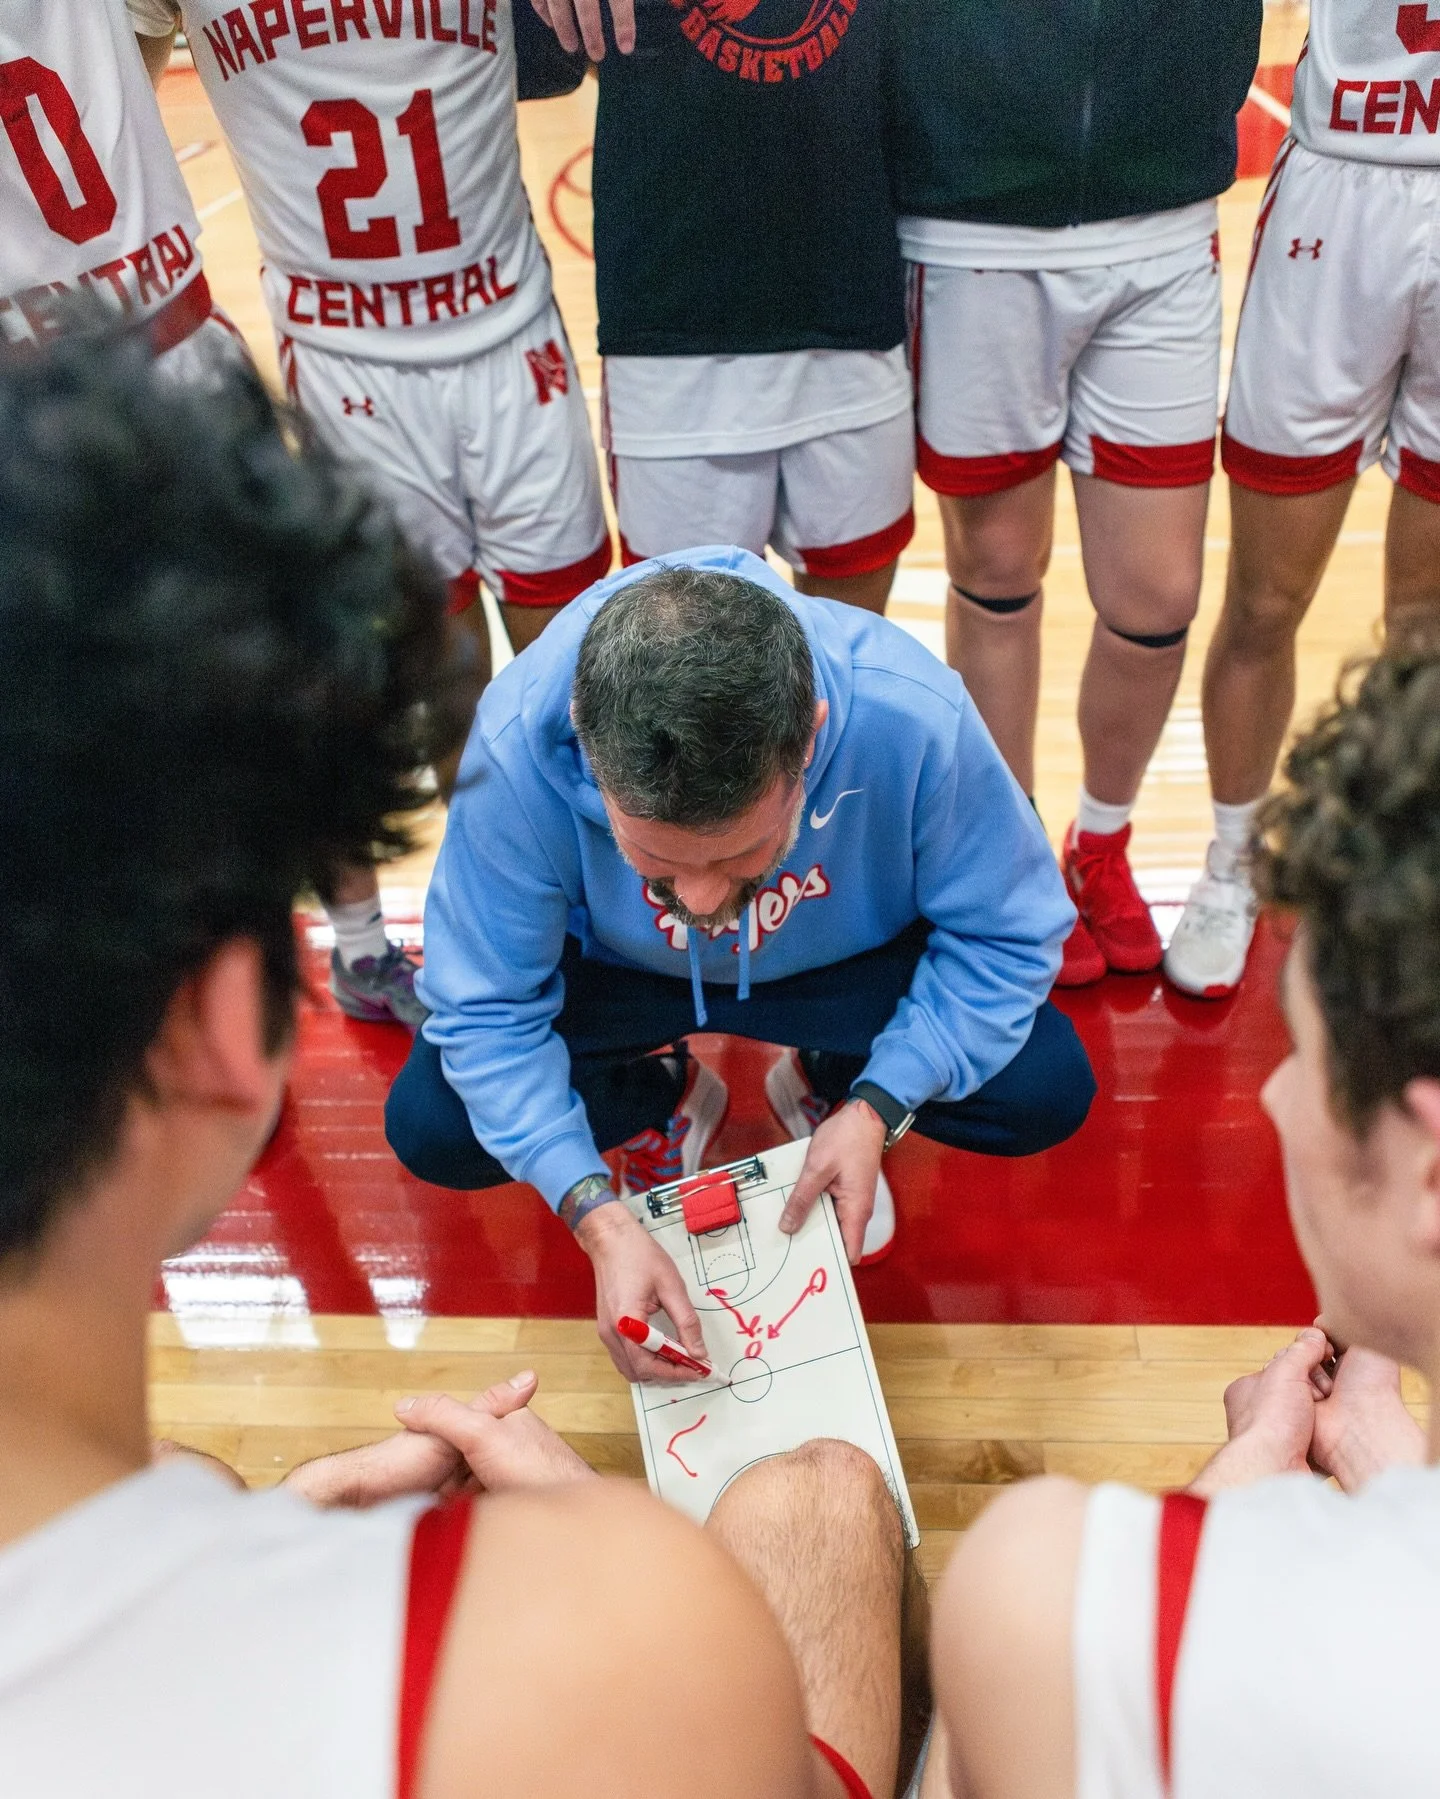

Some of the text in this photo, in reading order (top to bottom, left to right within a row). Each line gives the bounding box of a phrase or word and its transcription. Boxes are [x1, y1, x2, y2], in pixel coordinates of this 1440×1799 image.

[202, 0, 498, 82] NAPERVILLE
[1329, 78, 1440, 134] CEN
[300, 88, 461, 259] 21
[287, 255, 518, 328] CENTRAL
